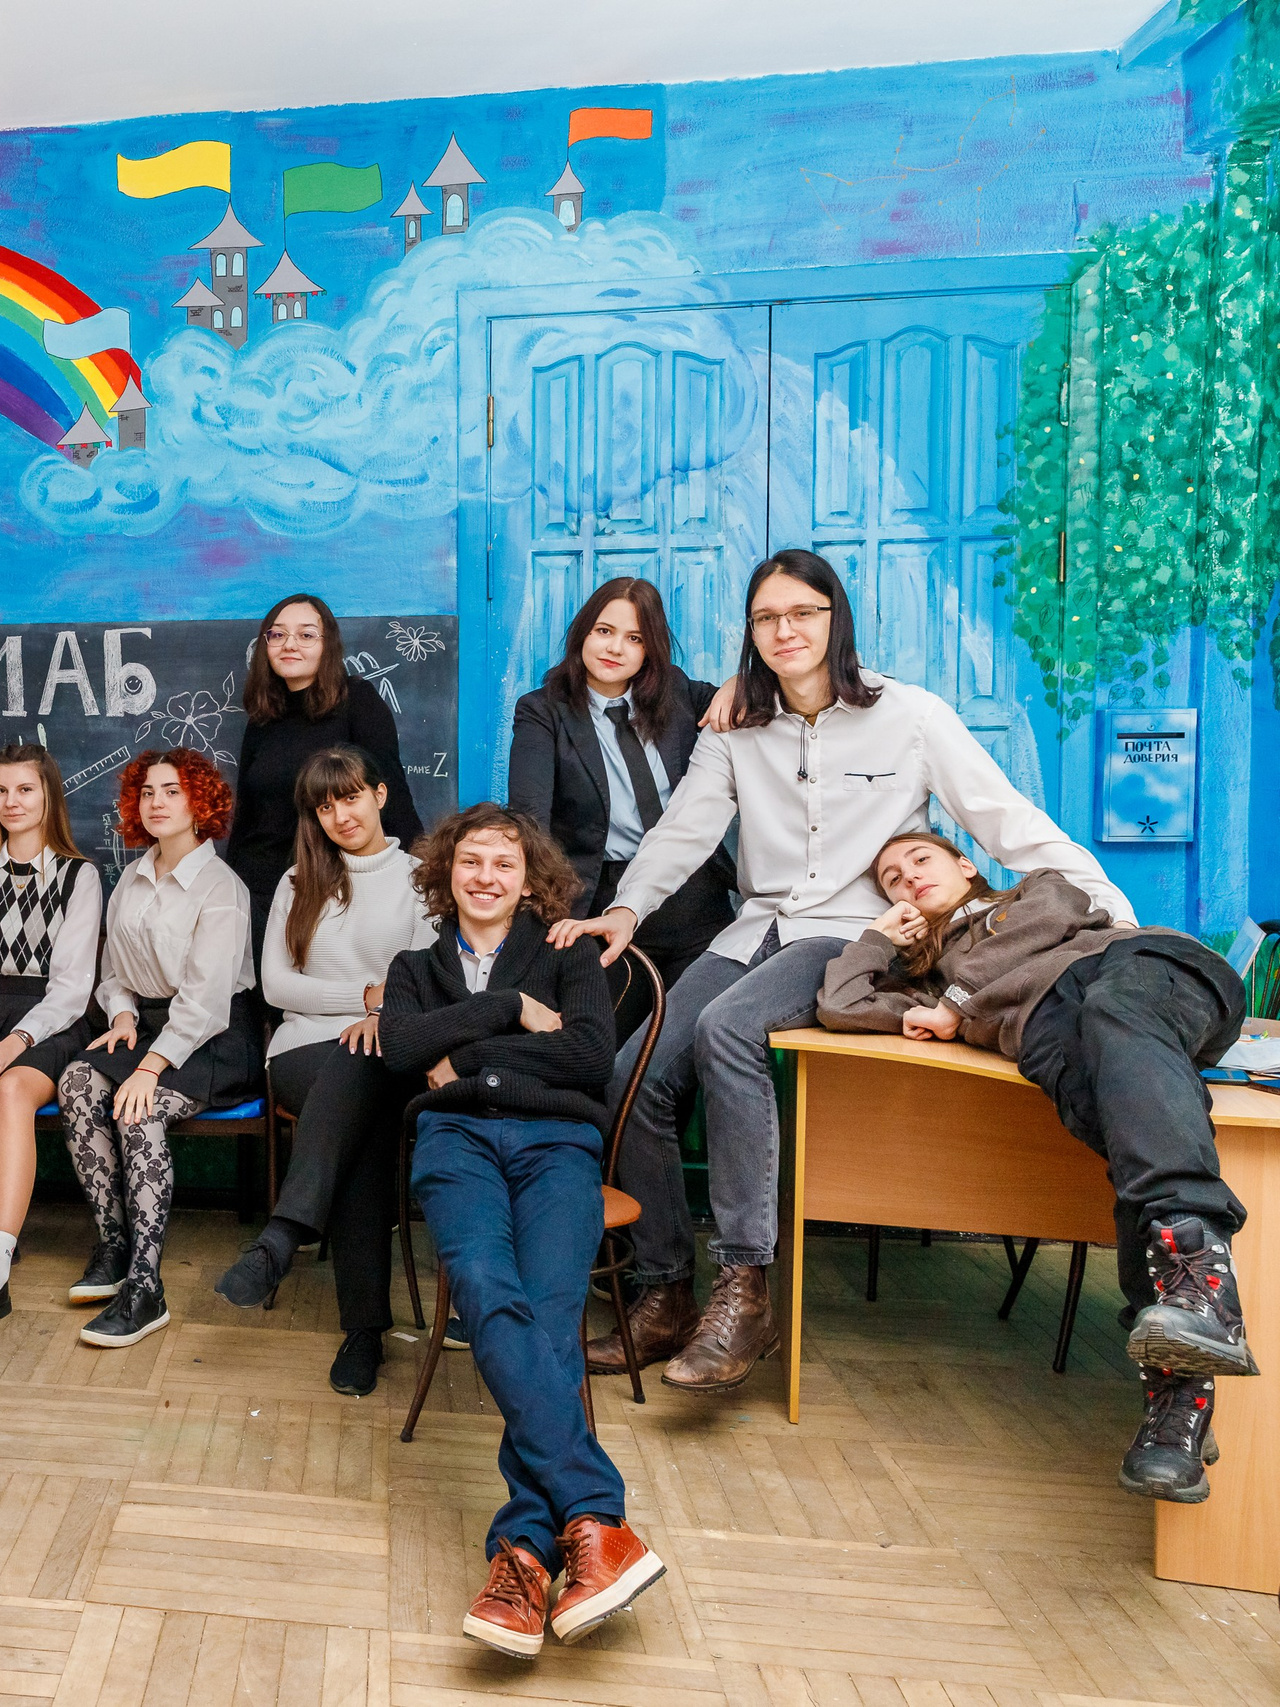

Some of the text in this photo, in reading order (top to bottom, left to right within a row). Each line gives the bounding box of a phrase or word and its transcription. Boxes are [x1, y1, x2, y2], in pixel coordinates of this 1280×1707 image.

[1124, 741, 1171, 752] ПОЧТА
[1123, 753, 1179, 764] ДОВЕРИЯ
[402, 752, 448, 777] РАНЕ Z
